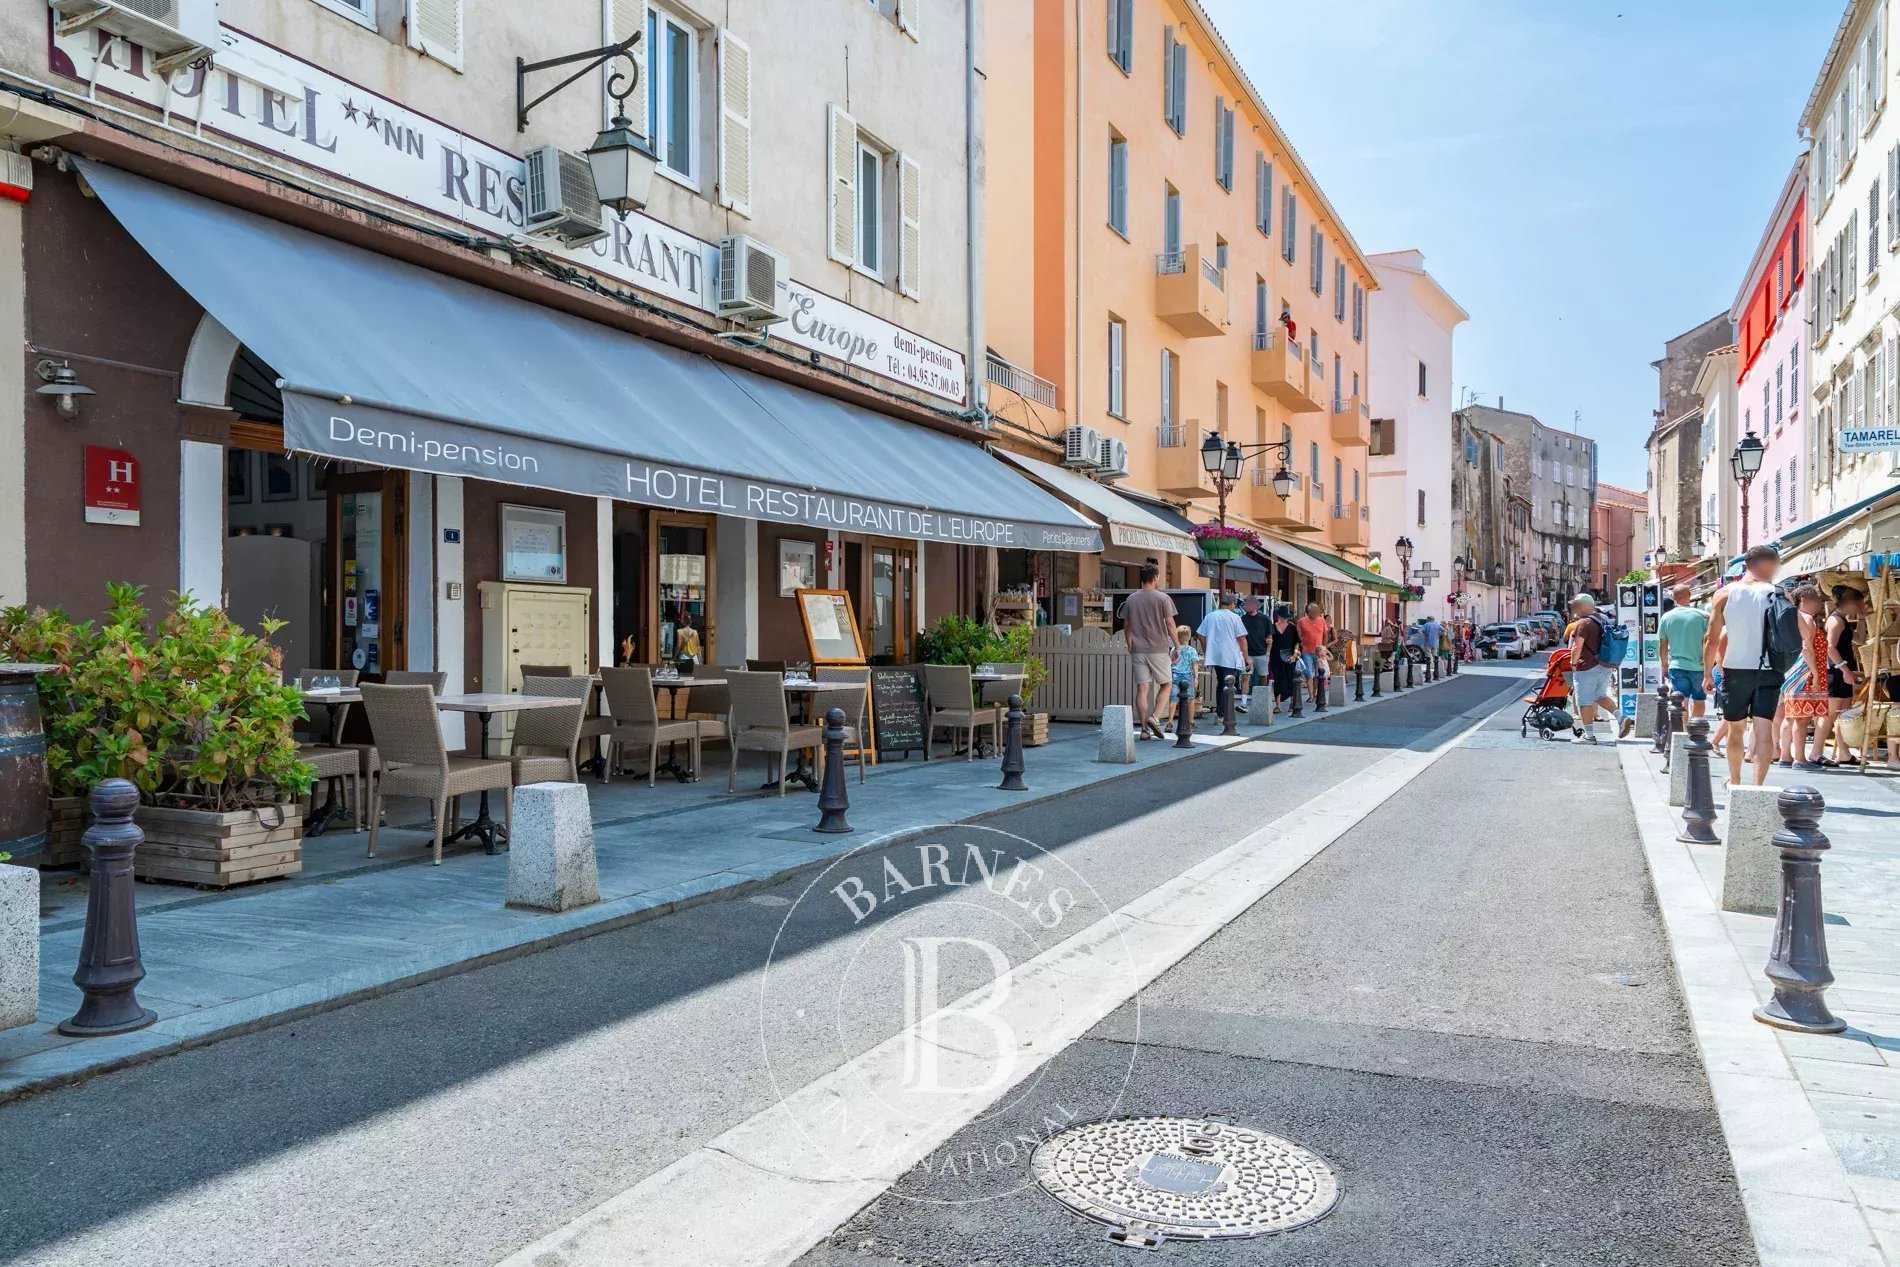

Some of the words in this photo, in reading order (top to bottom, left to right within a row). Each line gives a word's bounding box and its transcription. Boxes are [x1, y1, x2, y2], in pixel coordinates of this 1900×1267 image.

[894, 331, 952, 371] demi-pension
[329, 416, 538, 473] Demi-pension
[108, 459, 136, 483] H
[625, 463, 736, 509] HOTEL
[746, 484, 904, 533] RESTAURANT
[908, 511, 933, 535] DE
[938, 517, 1014, 544] L'EUROPE
